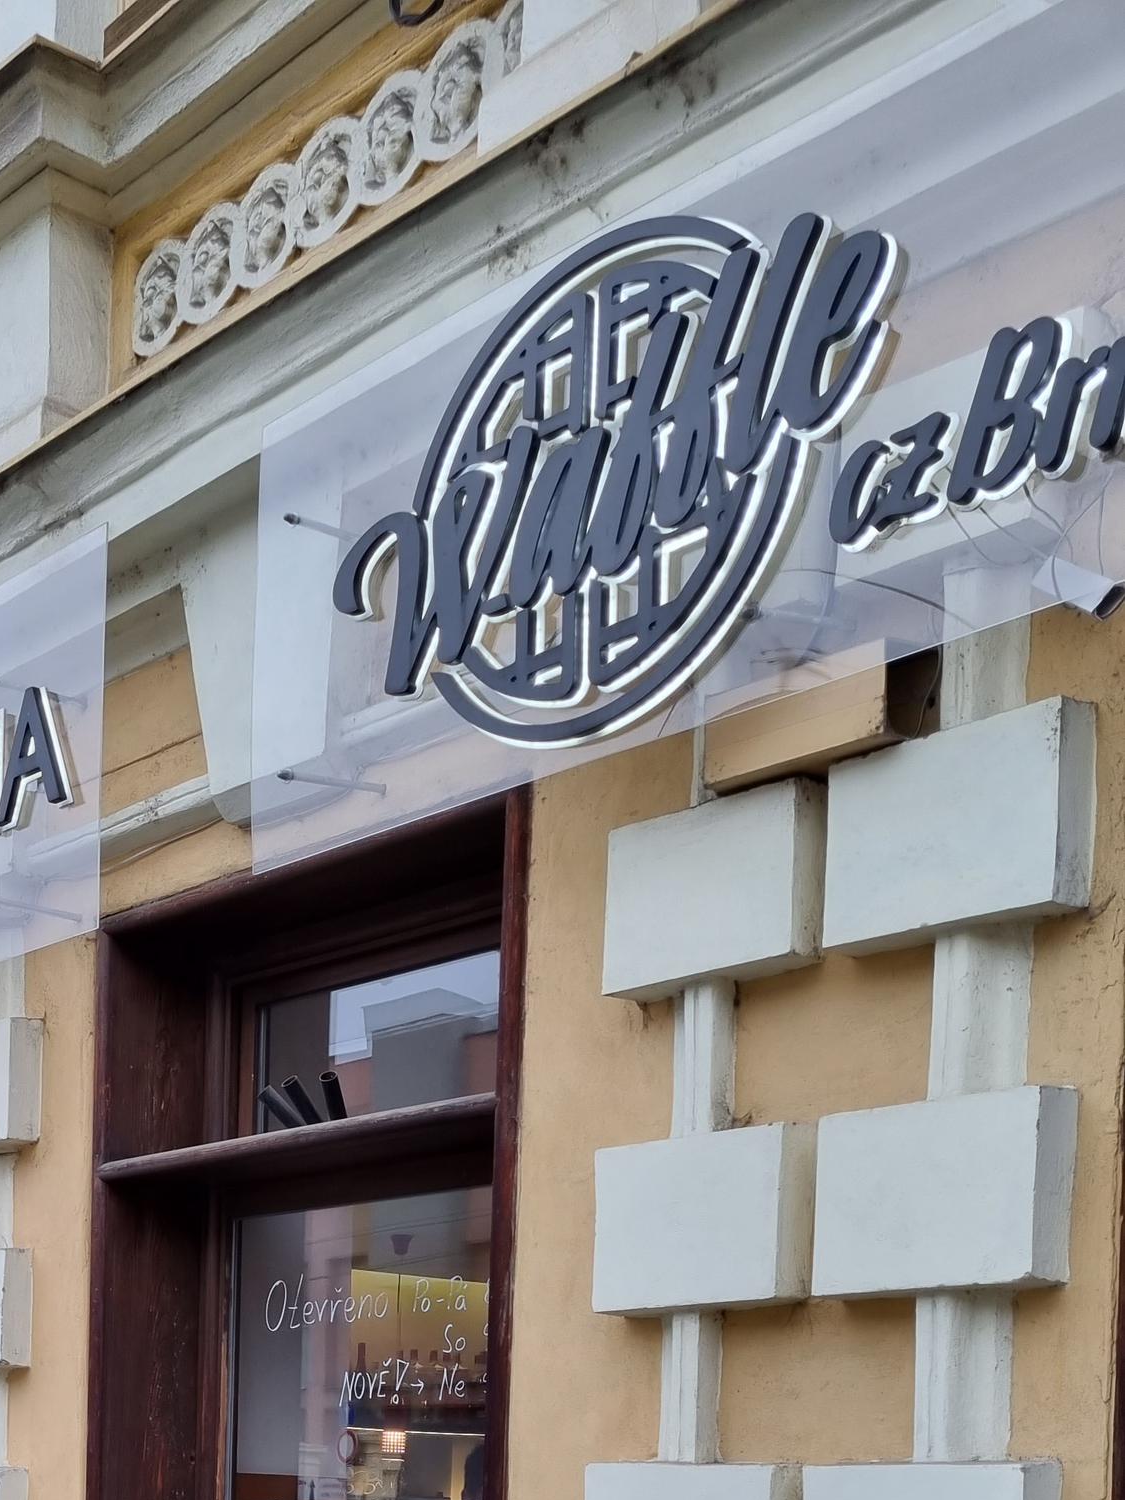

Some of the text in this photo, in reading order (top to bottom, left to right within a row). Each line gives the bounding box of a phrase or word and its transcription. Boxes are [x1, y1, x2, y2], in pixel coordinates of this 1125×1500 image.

[332, 212, 903, 698] Waffle
[264, 1273, 390, 1332] Otevřeno
[442, 1324, 467, 1353] So
[439, 1363, 466, 1401] Ne
